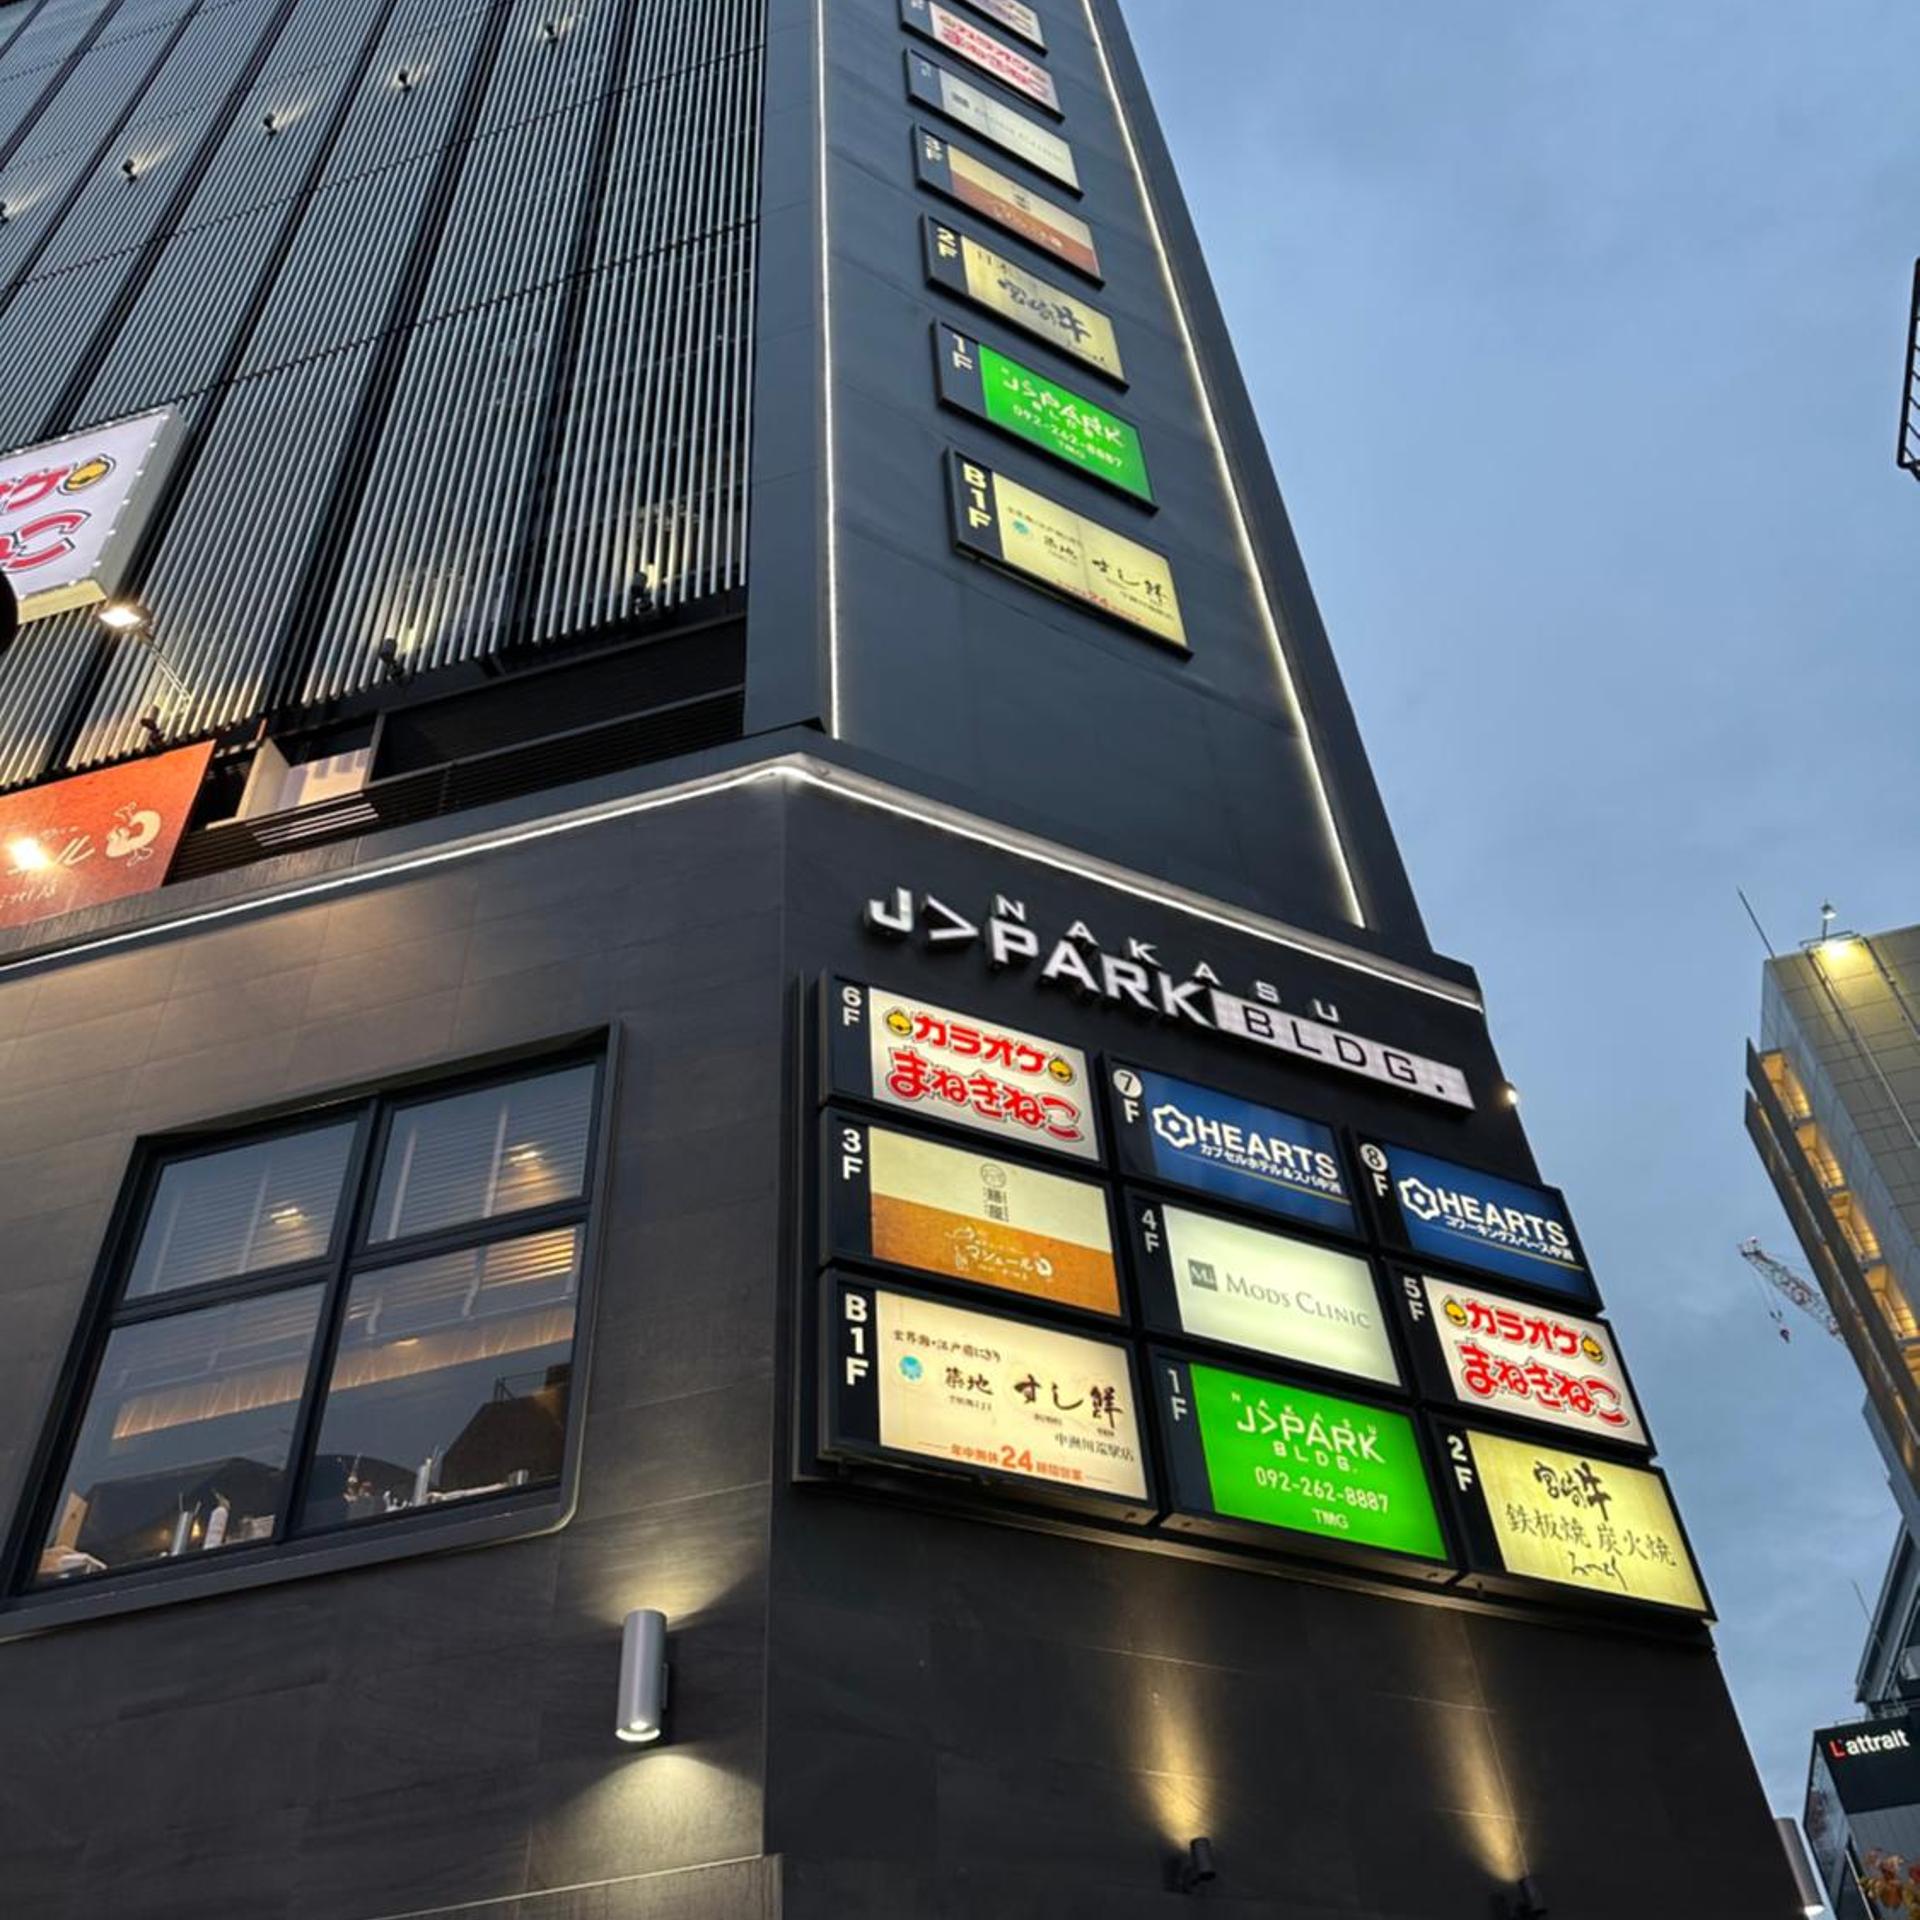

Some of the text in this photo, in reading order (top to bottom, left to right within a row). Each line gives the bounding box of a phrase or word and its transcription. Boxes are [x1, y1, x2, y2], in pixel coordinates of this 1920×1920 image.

[937, 227, 958, 258] 2F
[952, 334, 973, 370] 1F
[963, 463, 991, 528] B1F
[996, 893, 1340, 1022] NAKASU
[842, 986, 862, 1027] 6F
[913, 1014, 1047, 1073] カラオケ
[1242, 1005, 1445, 1093] BLDG.
[887, 1048, 1082, 1141] まねきねこ
[841, 1128, 863, 1179] 3F
[1196, 1116, 1338, 1181] HEARTS
[1141, 1209, 1159, 1253] 4F
[1436, 1187, 1569, 1247] HEARTS
[1403, 1276, 1425, 1322] 5F
[1464, 1301, 1581, 1356] カラオケ
[844, 1293, 869, 1386] B1F
[1168, 1369, 1188, 1421] 1F
[1457, 1341, 1629, 1425] まねきねこ
[1255, 1465, 1389, 1513] 092-262-8887
[1447, 1435, 1474, 1492] 2F
[1533, 1460, 1613, 1522] 宮崎牛
[1505, 1501, 1678, 1568] 鉄板焼 炭火焼
